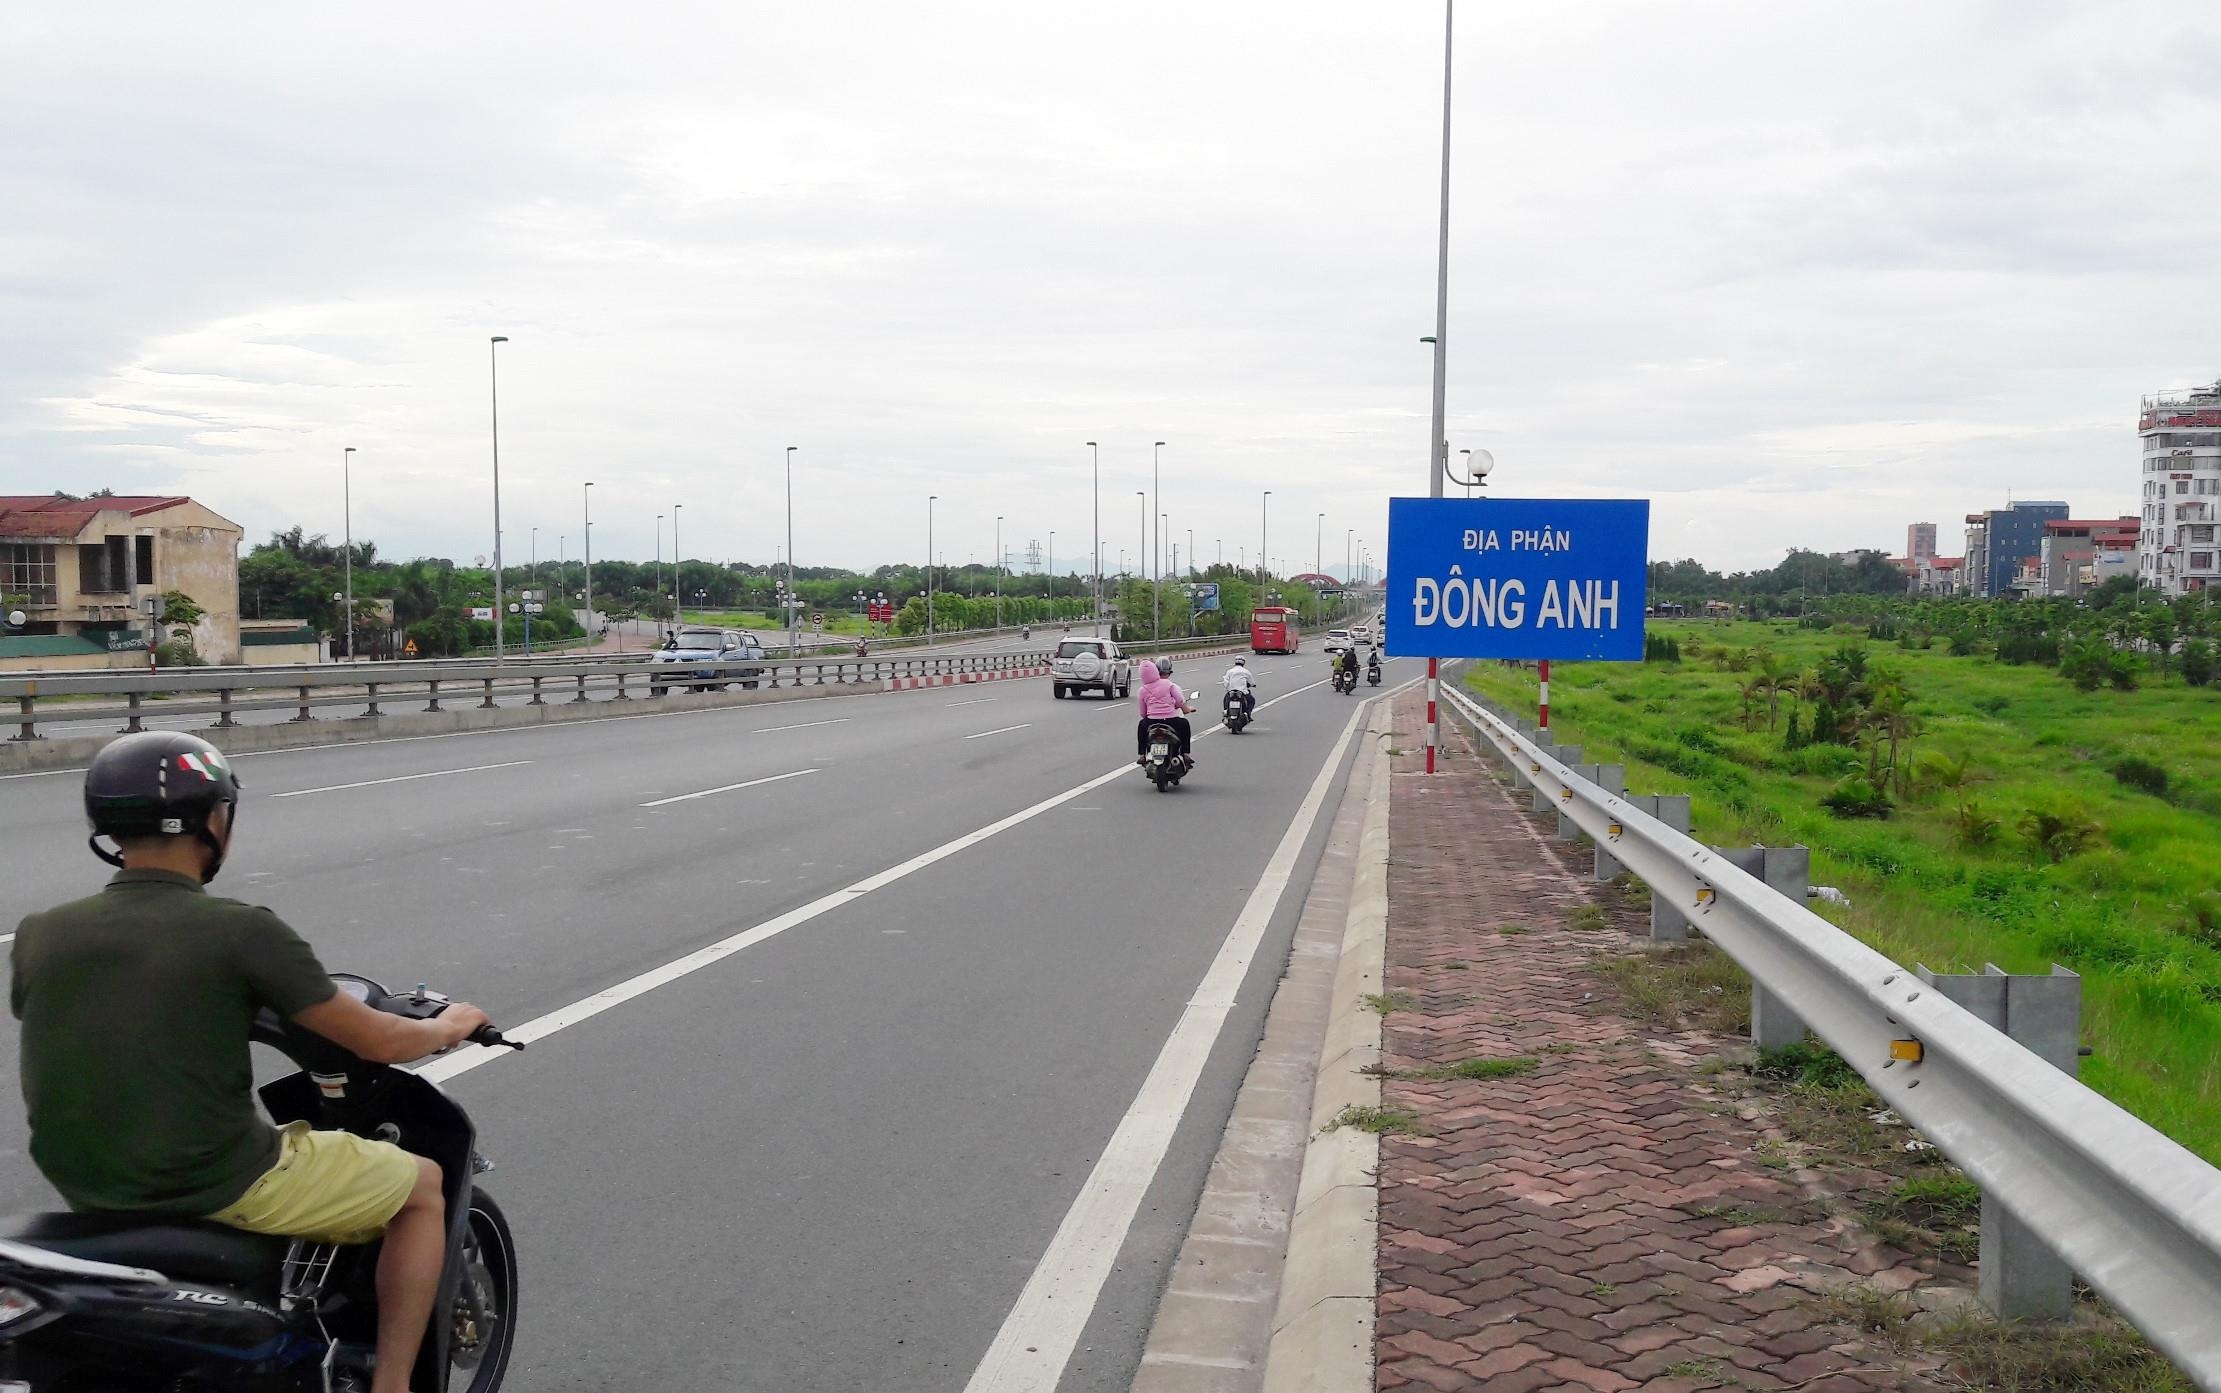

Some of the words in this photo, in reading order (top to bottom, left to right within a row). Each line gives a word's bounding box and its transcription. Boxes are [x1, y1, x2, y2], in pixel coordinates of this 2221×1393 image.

[1462, 529, 1500, 555] ĐỊA
[1511, 525, 1570, 556] PHẬN
[1413, 564, 1526, 629] ĐÔNG
[1536, 579, 1619, 629] ANH
